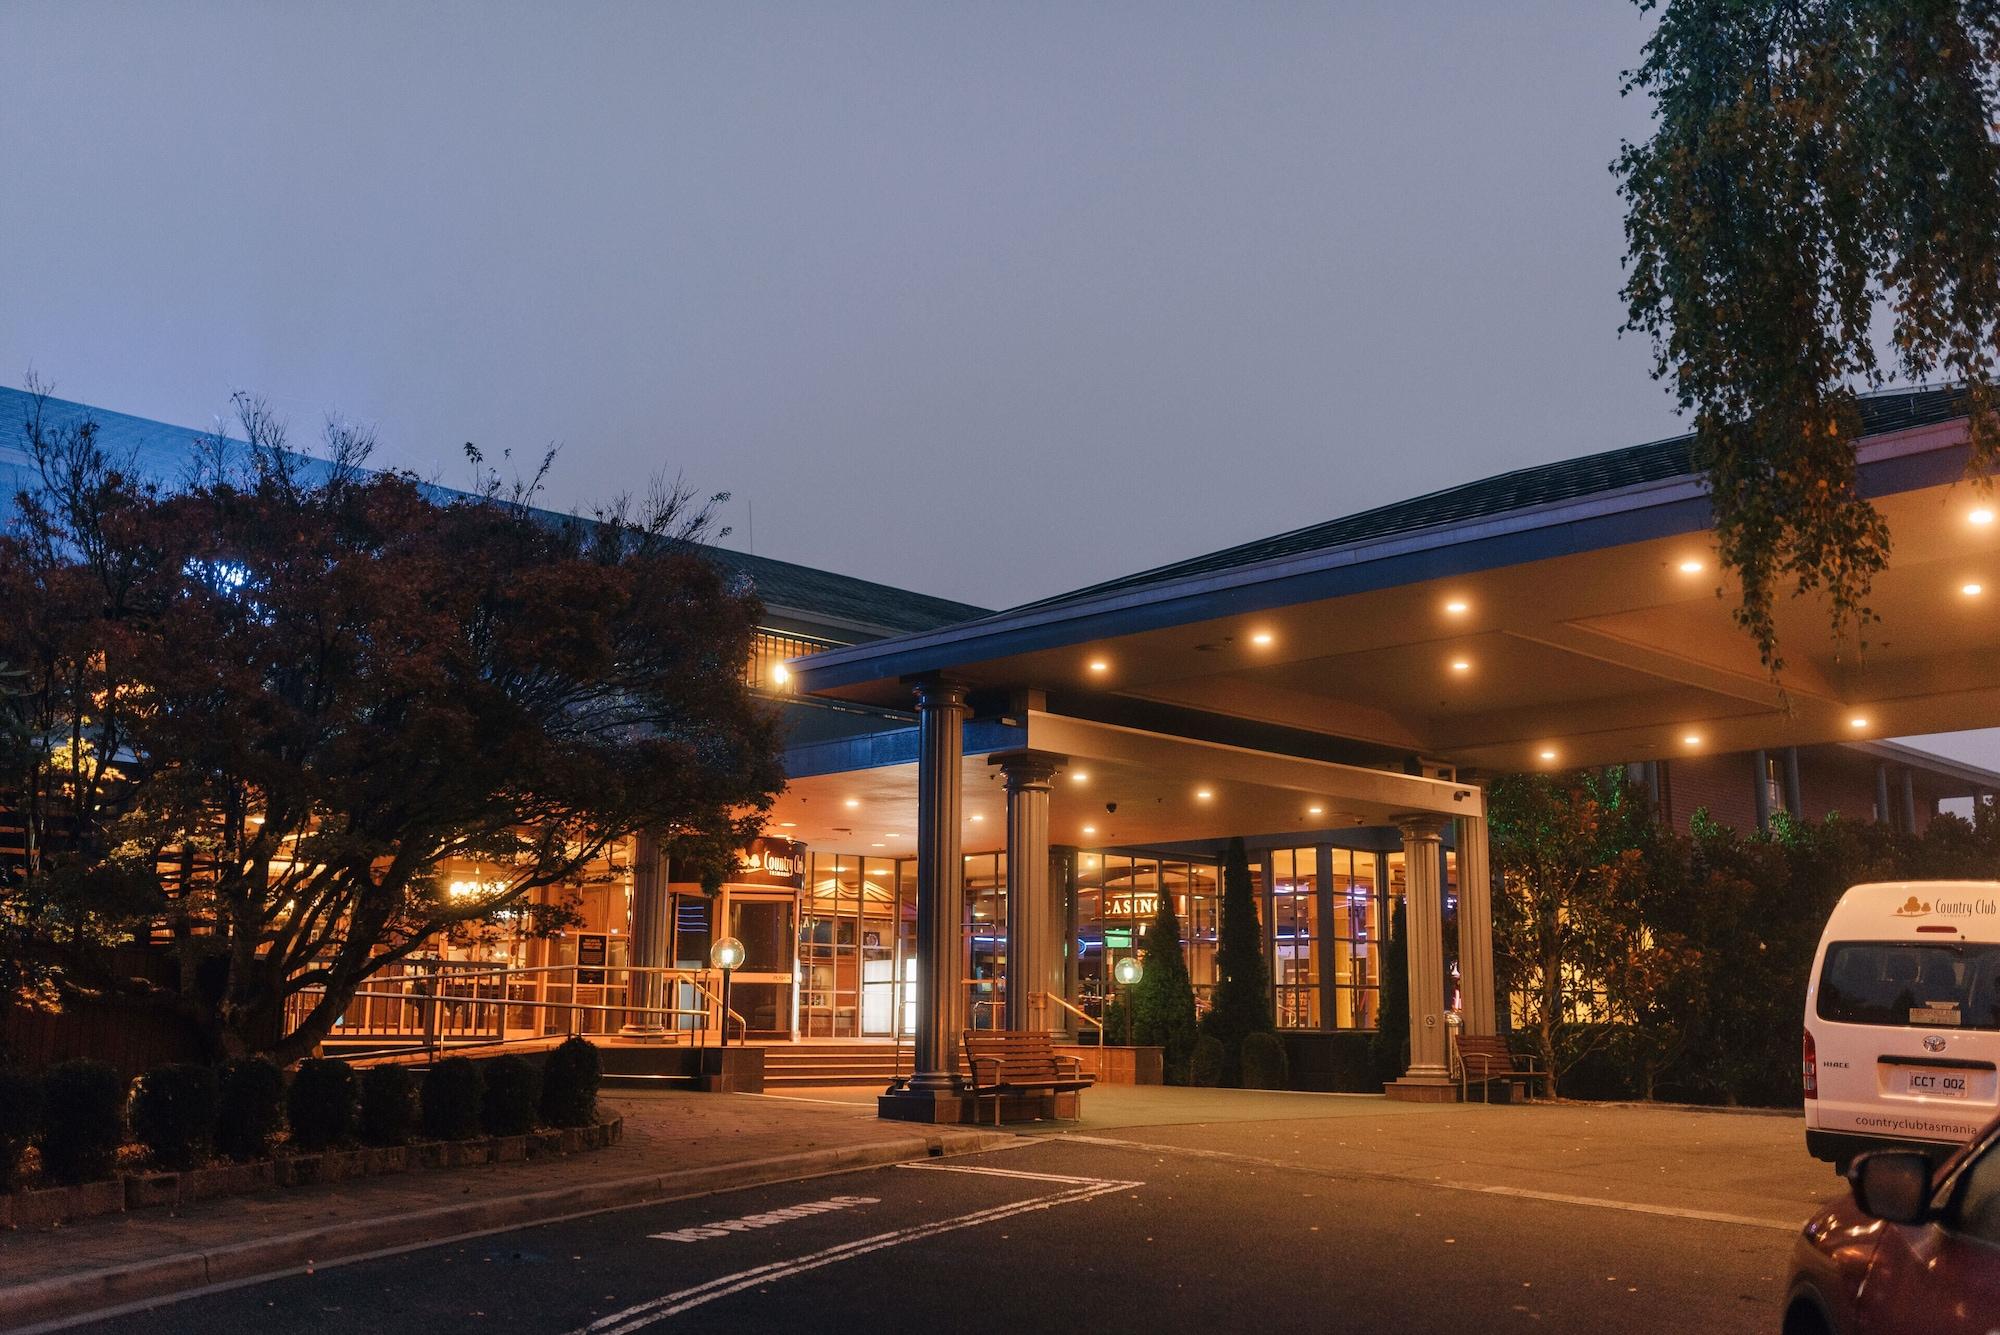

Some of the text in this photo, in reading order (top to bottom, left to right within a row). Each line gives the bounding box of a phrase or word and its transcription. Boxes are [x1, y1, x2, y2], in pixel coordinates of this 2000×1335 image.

[764, 850, 794, 876] Country
[1935, 898, 1997, 917] Country Club
[1823, 1060, 1850, 1069] HIACE
[1914, 1076, 1936, 1088] CCT
[1943, 1078, 1966, 1091] 002
